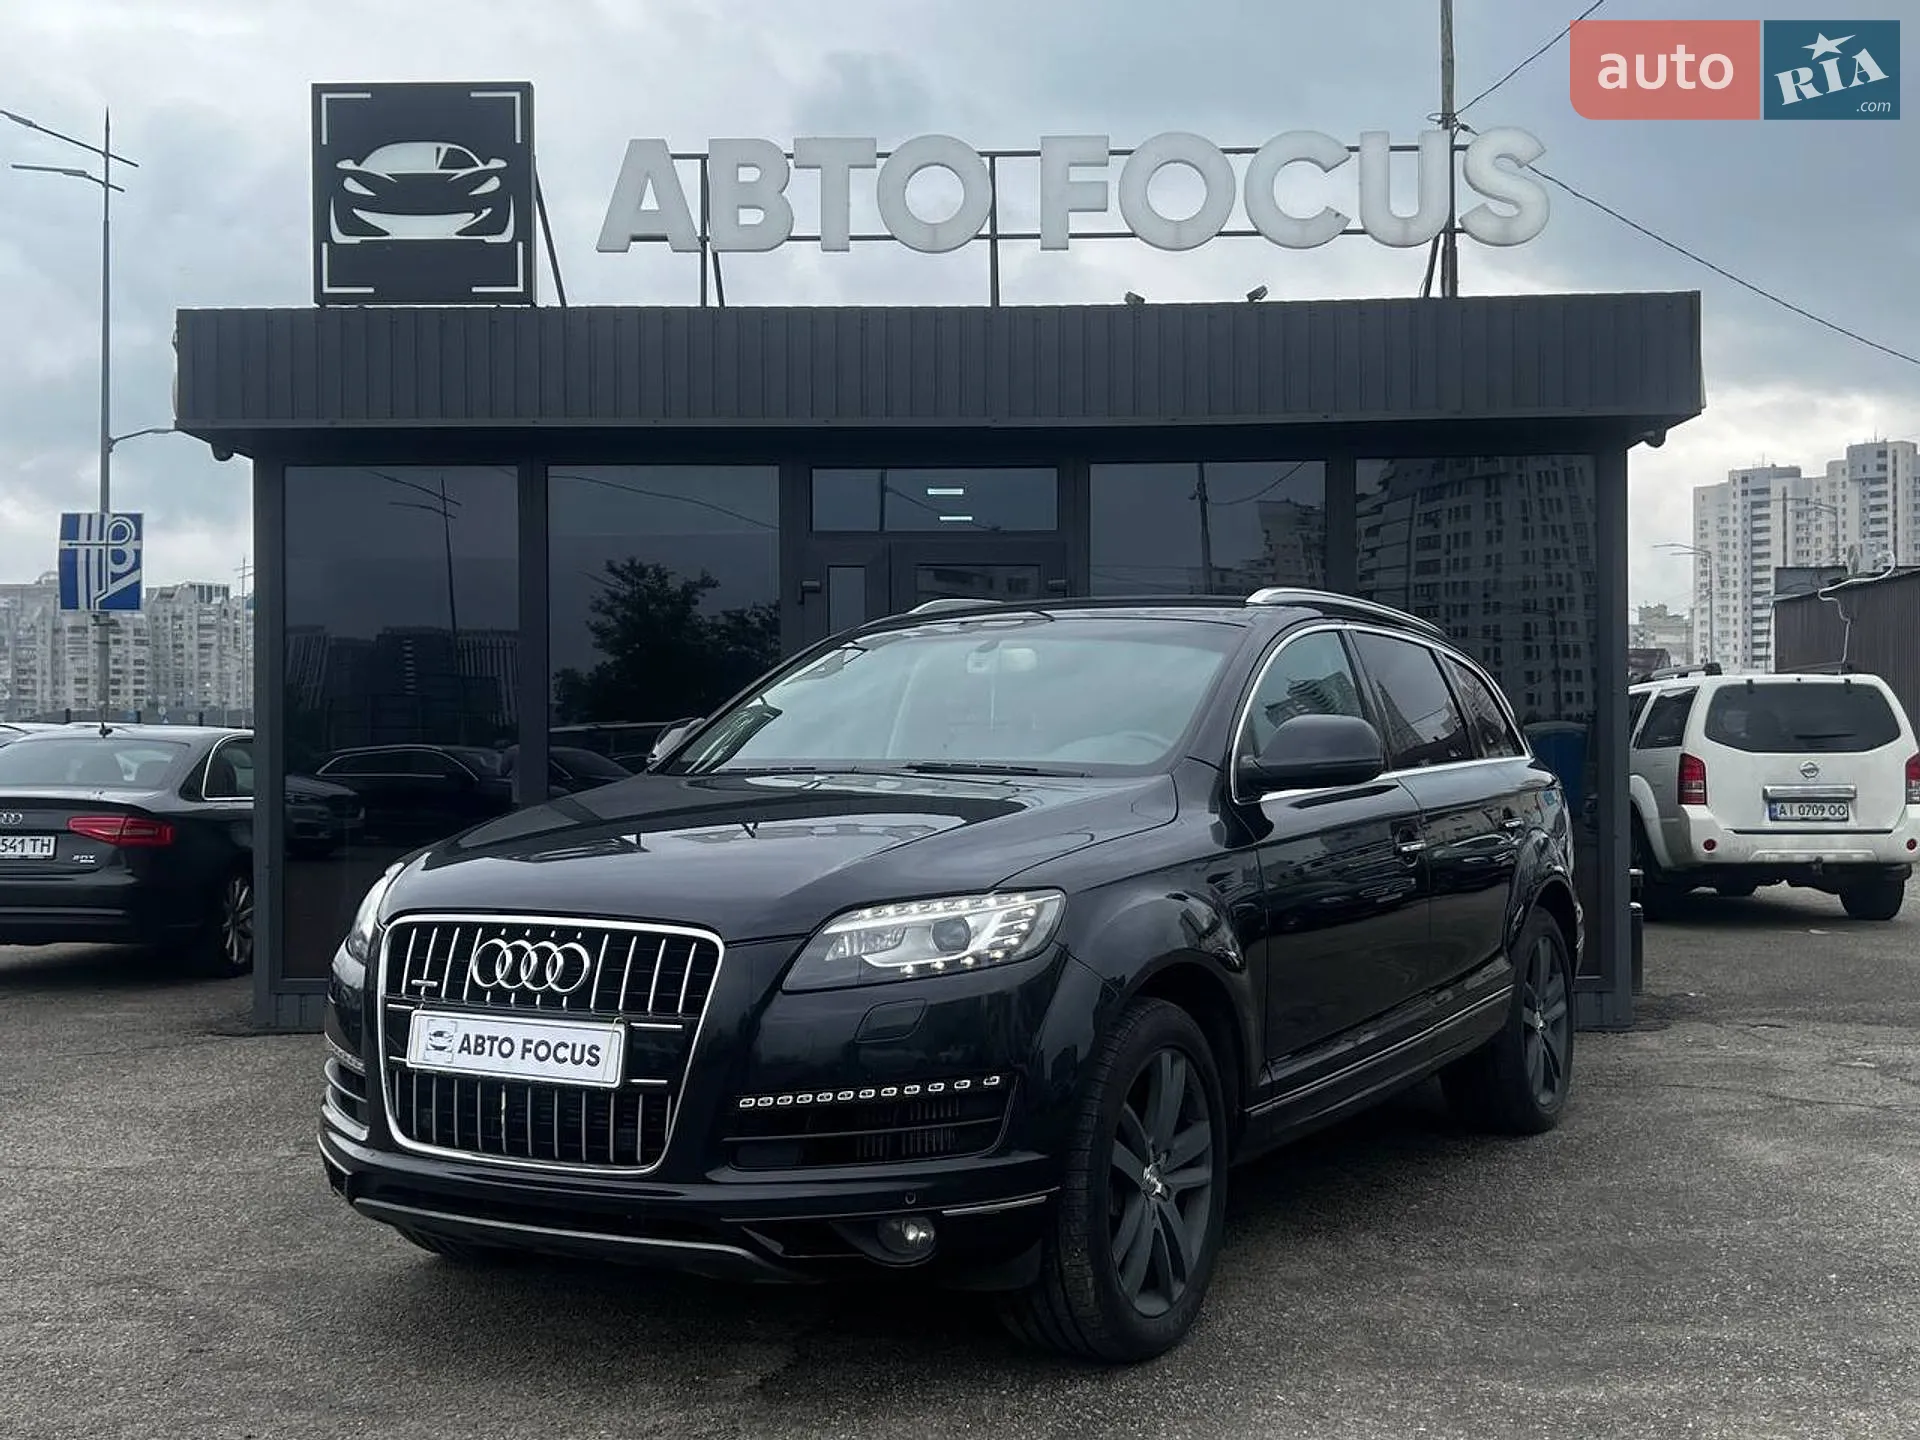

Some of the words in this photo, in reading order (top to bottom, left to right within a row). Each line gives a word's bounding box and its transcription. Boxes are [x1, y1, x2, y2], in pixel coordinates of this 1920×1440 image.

[596, 134, 993, 253] АВТО
[1040, 129, 1551, 251] FOCUS
[1798, 804, 1826, 816] 0709
[30, 838, 51, 853] TH
[457, 1033, 515, 1059] АВТО
[520, 1037, 601, 1067] FOCUS
